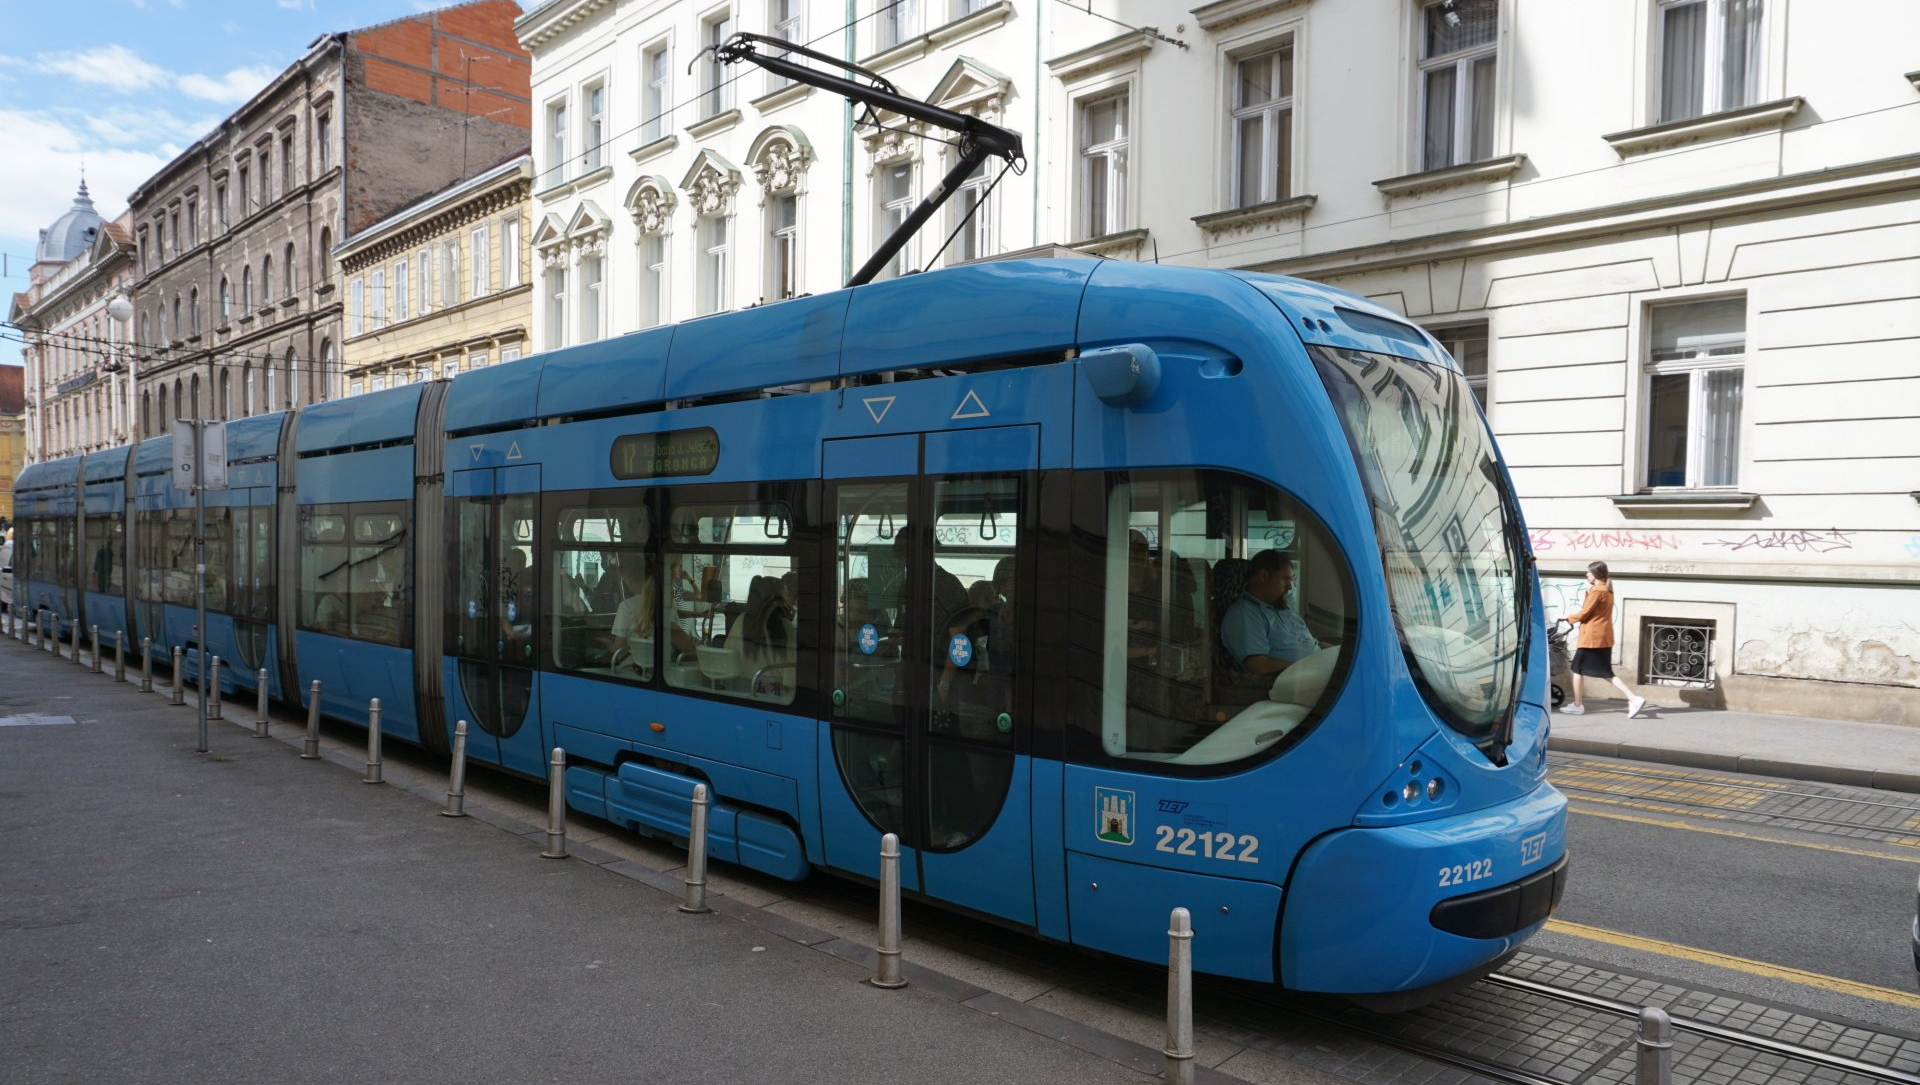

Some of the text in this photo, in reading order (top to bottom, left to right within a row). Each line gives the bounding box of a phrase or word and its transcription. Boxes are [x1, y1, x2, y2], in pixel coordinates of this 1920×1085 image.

[1157, 799, 1189, 814] ZET
[1155, 825, 1259, 864] 22122
[1438, 858, 1493, 887] 22122
